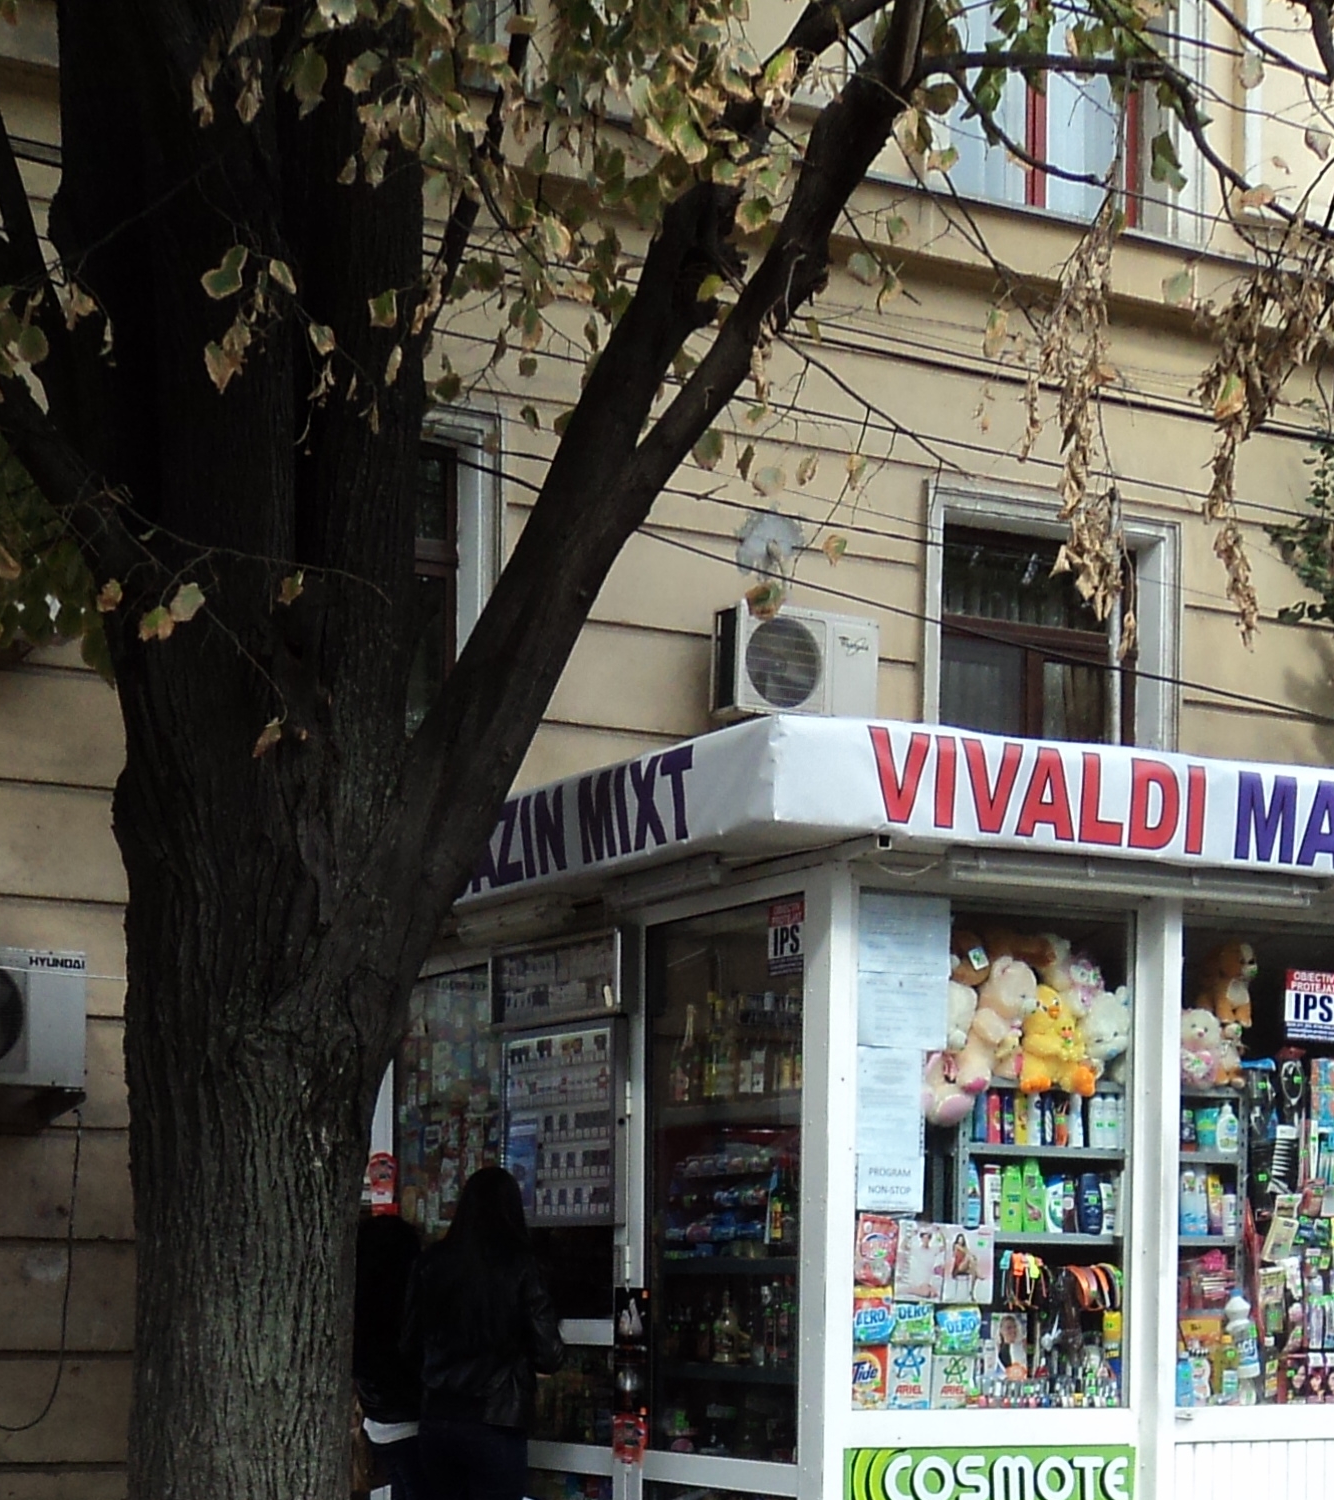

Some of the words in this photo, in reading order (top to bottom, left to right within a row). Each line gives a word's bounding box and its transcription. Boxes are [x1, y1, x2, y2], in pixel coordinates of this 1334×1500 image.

[867, 724, 1206, 855] VIVALDI
[577, 744, 694, 865] MIXT
[773, 924, 800, 957] IPS
[29, 955, 85, 970] HYUNDAI
[1293, 992, 1333, 1023] IPS
[868, 1166, 911, 1177] PROGRAM
[868, 1185, 912, 1195] NON-STOP
[947, 1318, 976, 1334] DERO
[853, 1360, 878, 1385] Tide
[895, 1384, 923, 1395] ARIEL
[940, 1385, 964, 1395] ARIEL
